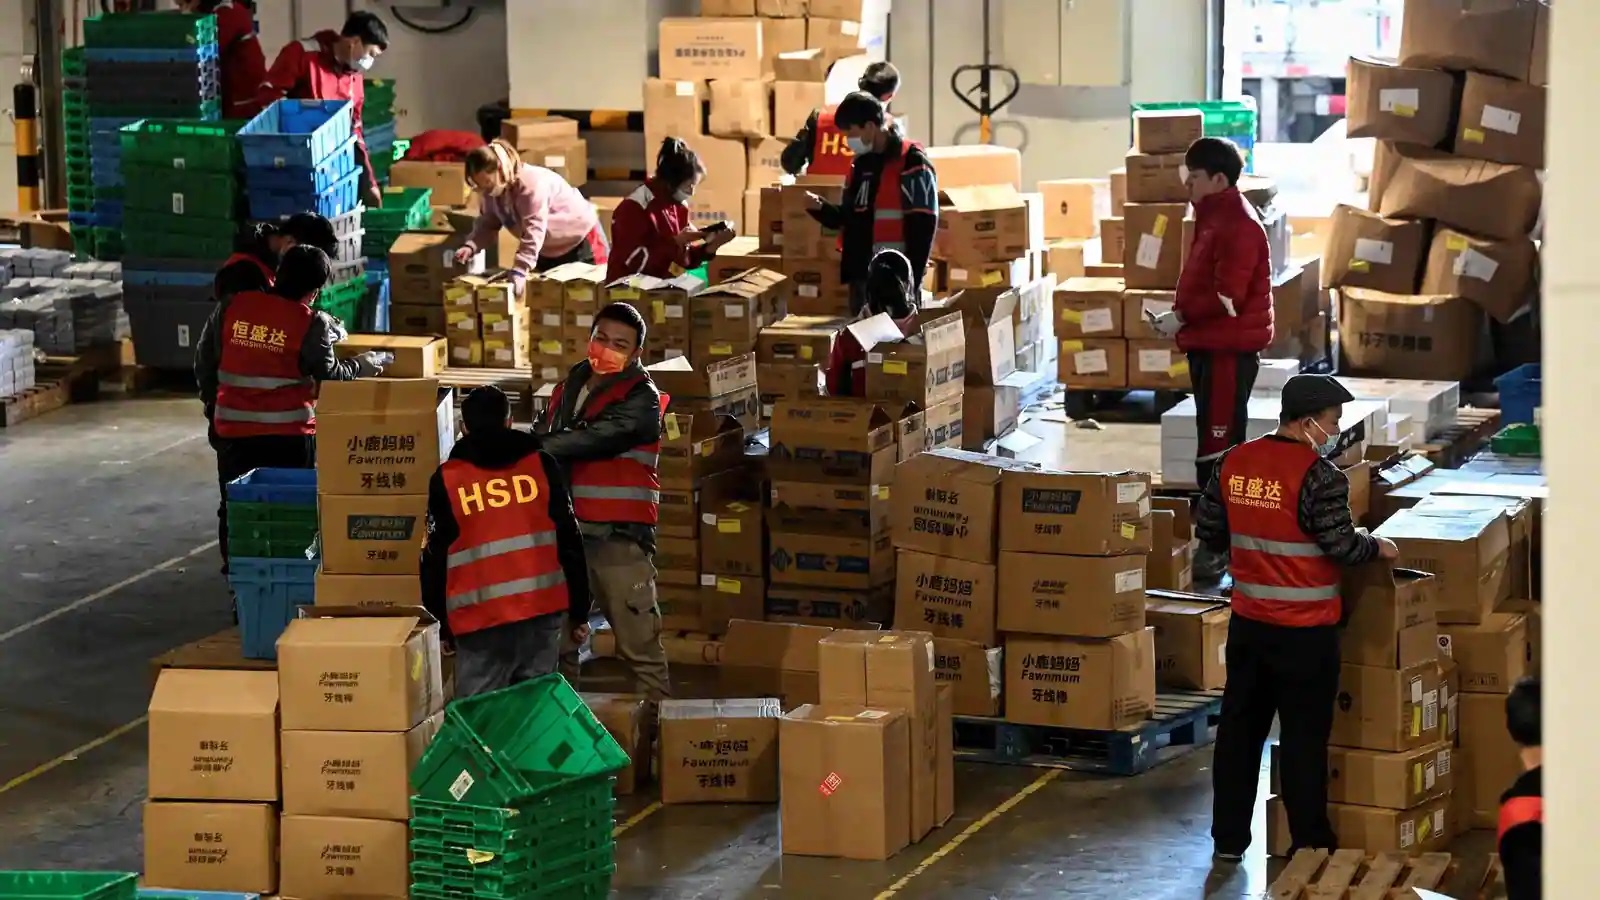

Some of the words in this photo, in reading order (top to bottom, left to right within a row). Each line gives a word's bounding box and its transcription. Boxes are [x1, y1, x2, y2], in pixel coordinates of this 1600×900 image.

[820, 131, 855, 156] HS
[232, 319, 288, 347] 恒盛达
[346, 434, 416, 452] 小鹿妈妈
[347, 453, 416, 465] Fawnmum
[360, 471, 408, 489] 牙线棒
[1228, 474, 1282, 501] 恒盛达
[457, 474, 539, 516] HSD
[915, 572, 973, 597] 小鹿妈妈
[1021, 652, 1081, 672] 小鹿妈妈
[1021, 670, 1081, 683] Fawnmum
[1032, 688, 1068, 706] 牙线棒
